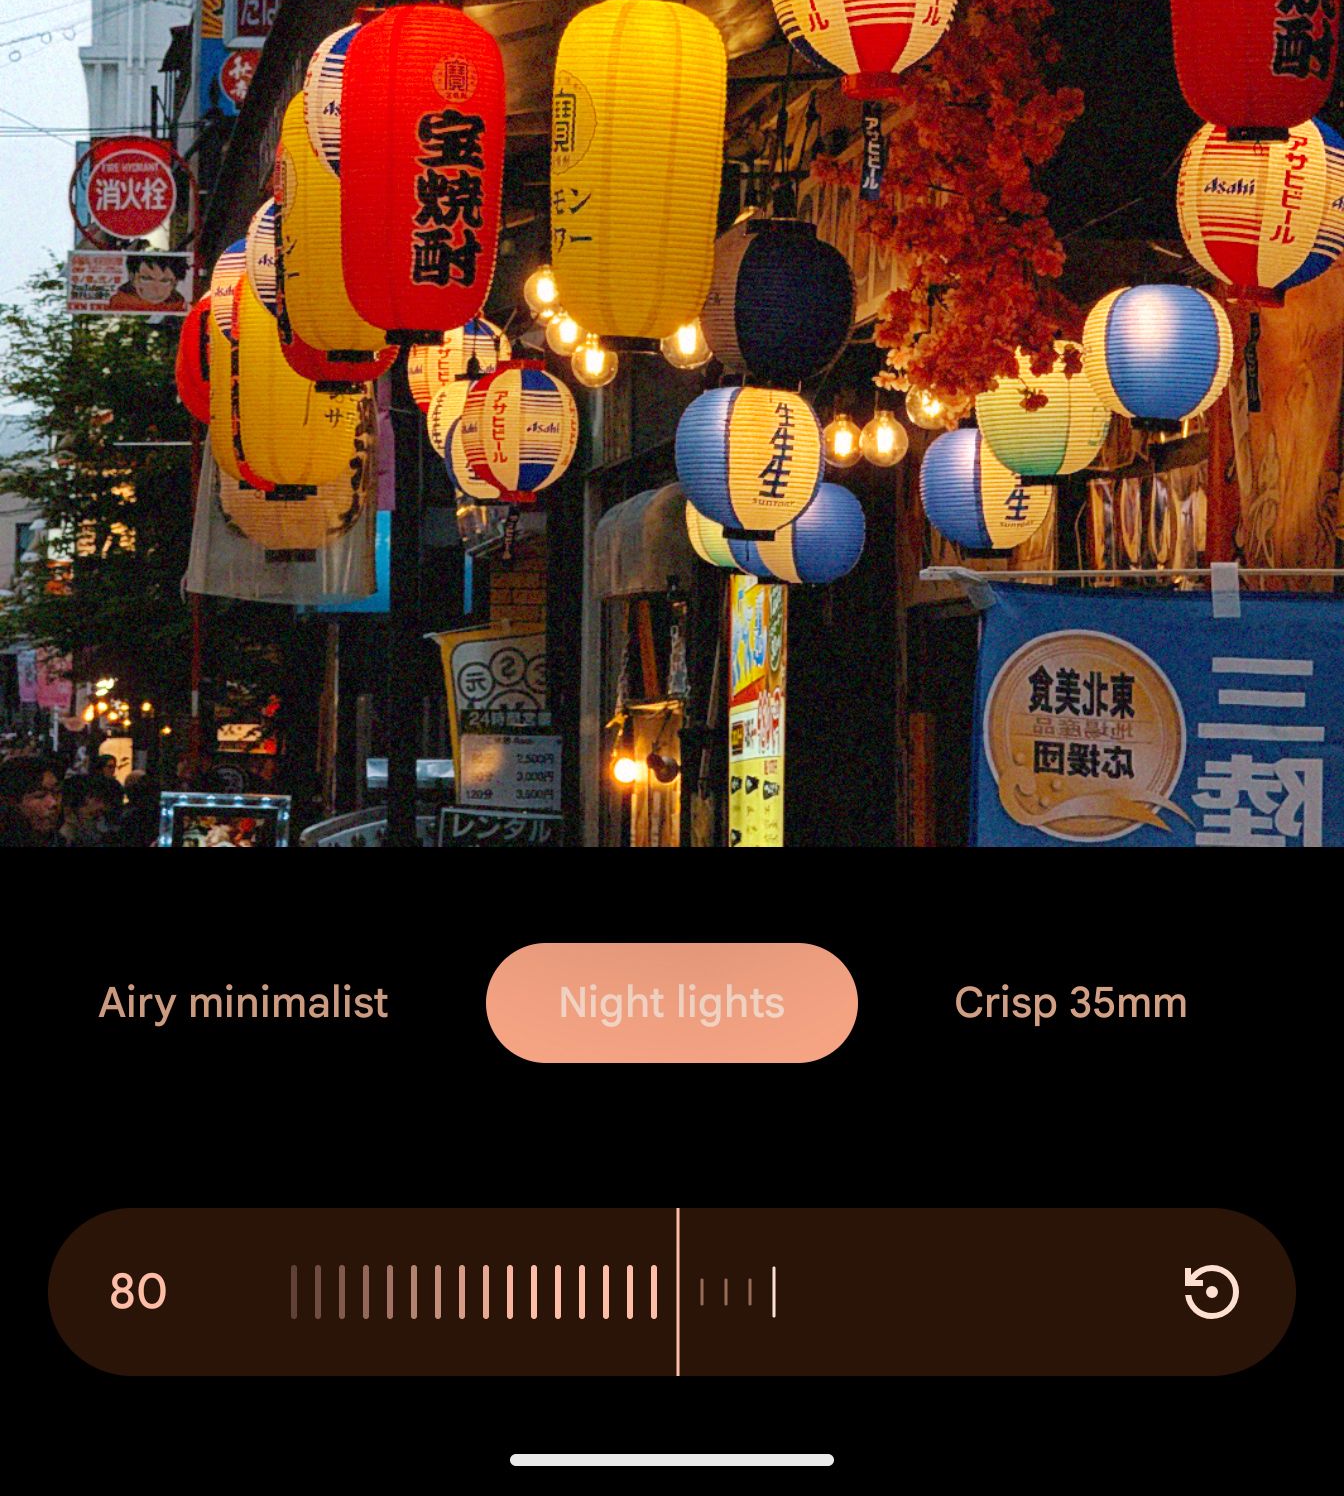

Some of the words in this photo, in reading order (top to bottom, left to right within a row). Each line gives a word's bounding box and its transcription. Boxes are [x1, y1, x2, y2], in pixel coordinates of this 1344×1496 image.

[96, 176, 169, 211] 消火栓
[412, 108, 486, 288] 宝焼酎
[1203, 177, 1256, 196] Asahi
[1269, 134, 1308, 245] アサヒビール
[492, 390, 509, 464] アサヒビール
[526, 420, 561, 435] Asahi
[758, 402, 796, 499] 生生生
[453, 814, 552, 843] レンタル
[98, 984, 176, 1026] Airy
[191, 984, 388, 1018] minimalist
[561, 984, 663, 1027] Night
[679, 984, 784, 1027] lights
[956, 984, 1056, 1026] Crisp
[1070, 986, 1186, 1018] 35mm
[111, 1273, 166, 1309] 80
